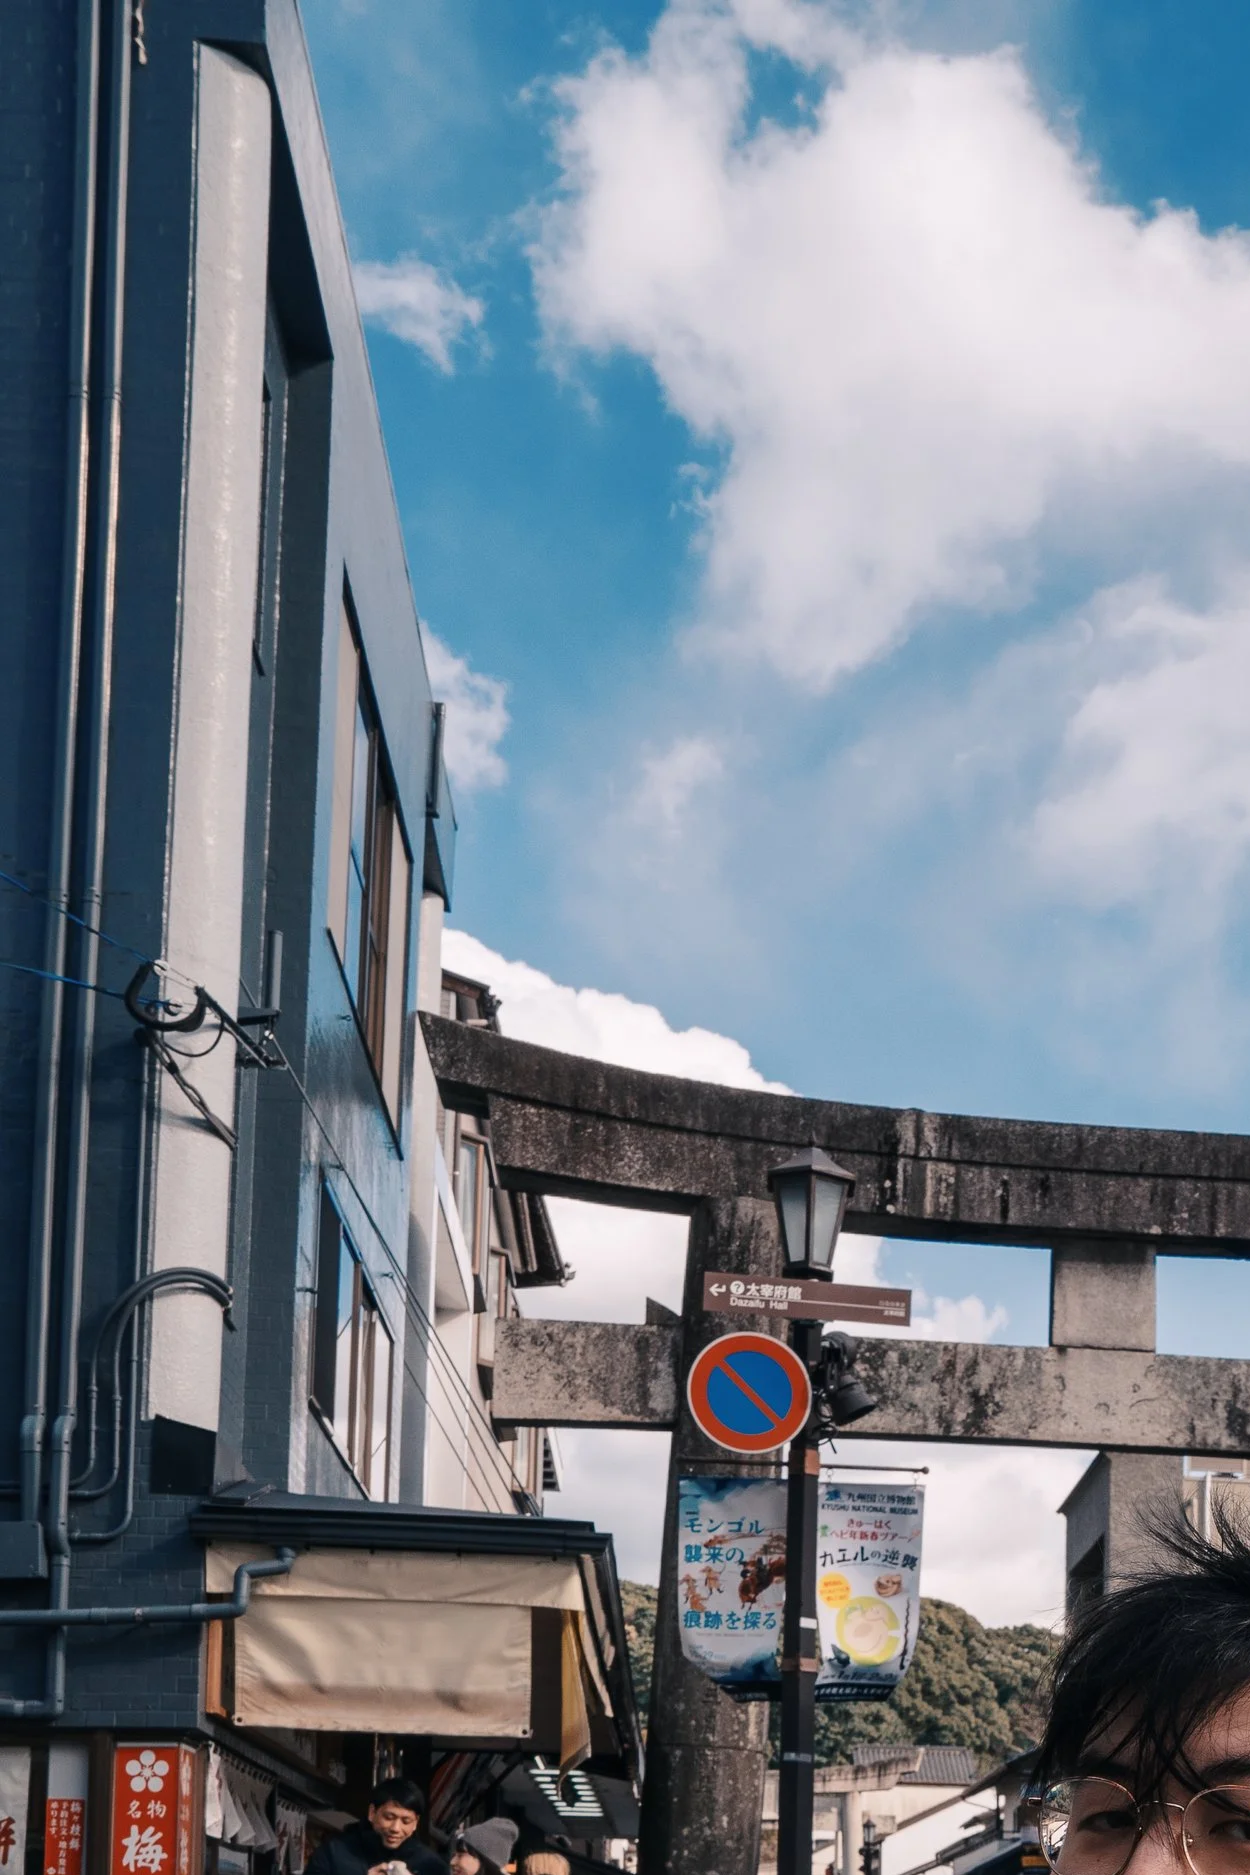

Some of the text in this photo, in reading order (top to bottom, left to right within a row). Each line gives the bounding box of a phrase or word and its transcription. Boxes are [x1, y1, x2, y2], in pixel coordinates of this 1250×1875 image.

[746, 1282, 802, 1301] 太宰府館
[729, 1297, 789, 1310] Dazaifu Hall
[847, 1492, 916, 1505] 九州国立博物館
[821, 1503, 919, 1516] KYUSHU NATIONAL MUSEUM
[684, 1516, 766, 1534] モンゴル
[684, 1544, 745, 1564] 襲来の
[819, 1545, 919, 1571] カエルの逆襲
[683, 1610, 777, 1631] 痕跡を探る
[127, 1799, 167, 1819] 名物
